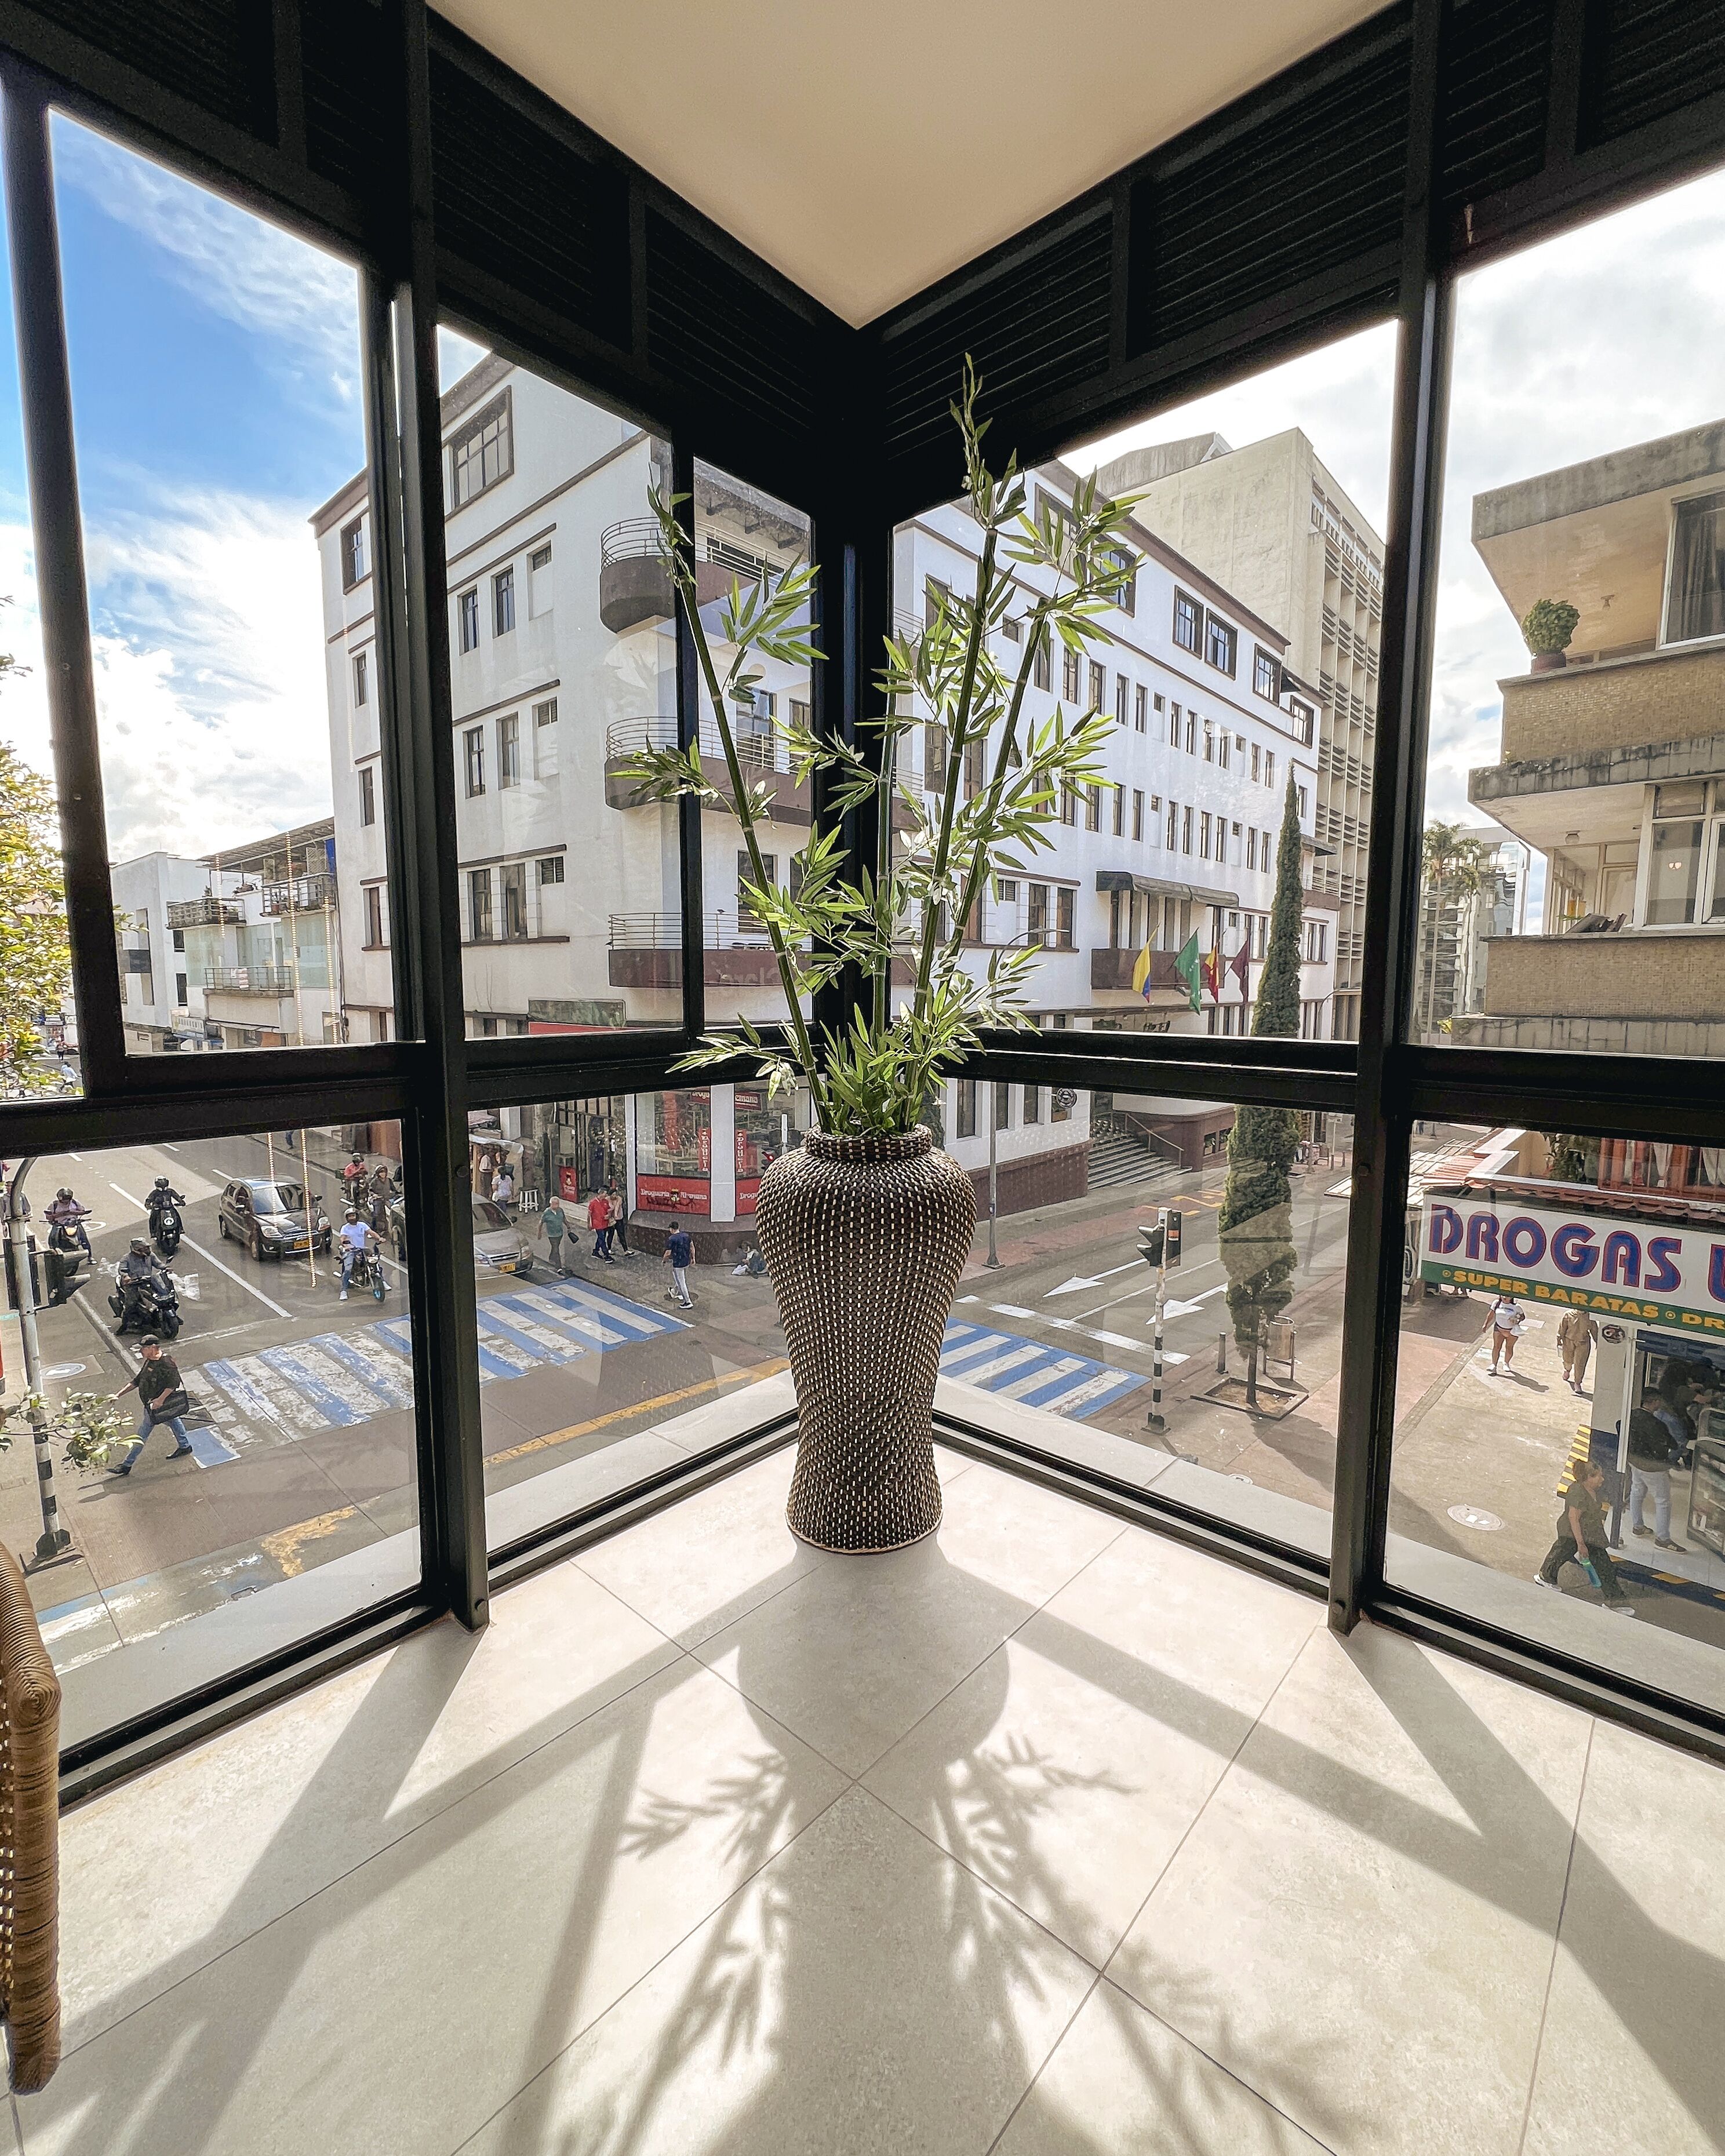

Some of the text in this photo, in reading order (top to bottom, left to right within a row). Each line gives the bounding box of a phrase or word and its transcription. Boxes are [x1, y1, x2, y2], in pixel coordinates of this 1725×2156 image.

[1428, 1203, 1682, 1292] DROGAS
[1453, 1270, 1529, 1295] SUPER
[1535, 1284, 1659, 1319] BARATAS
